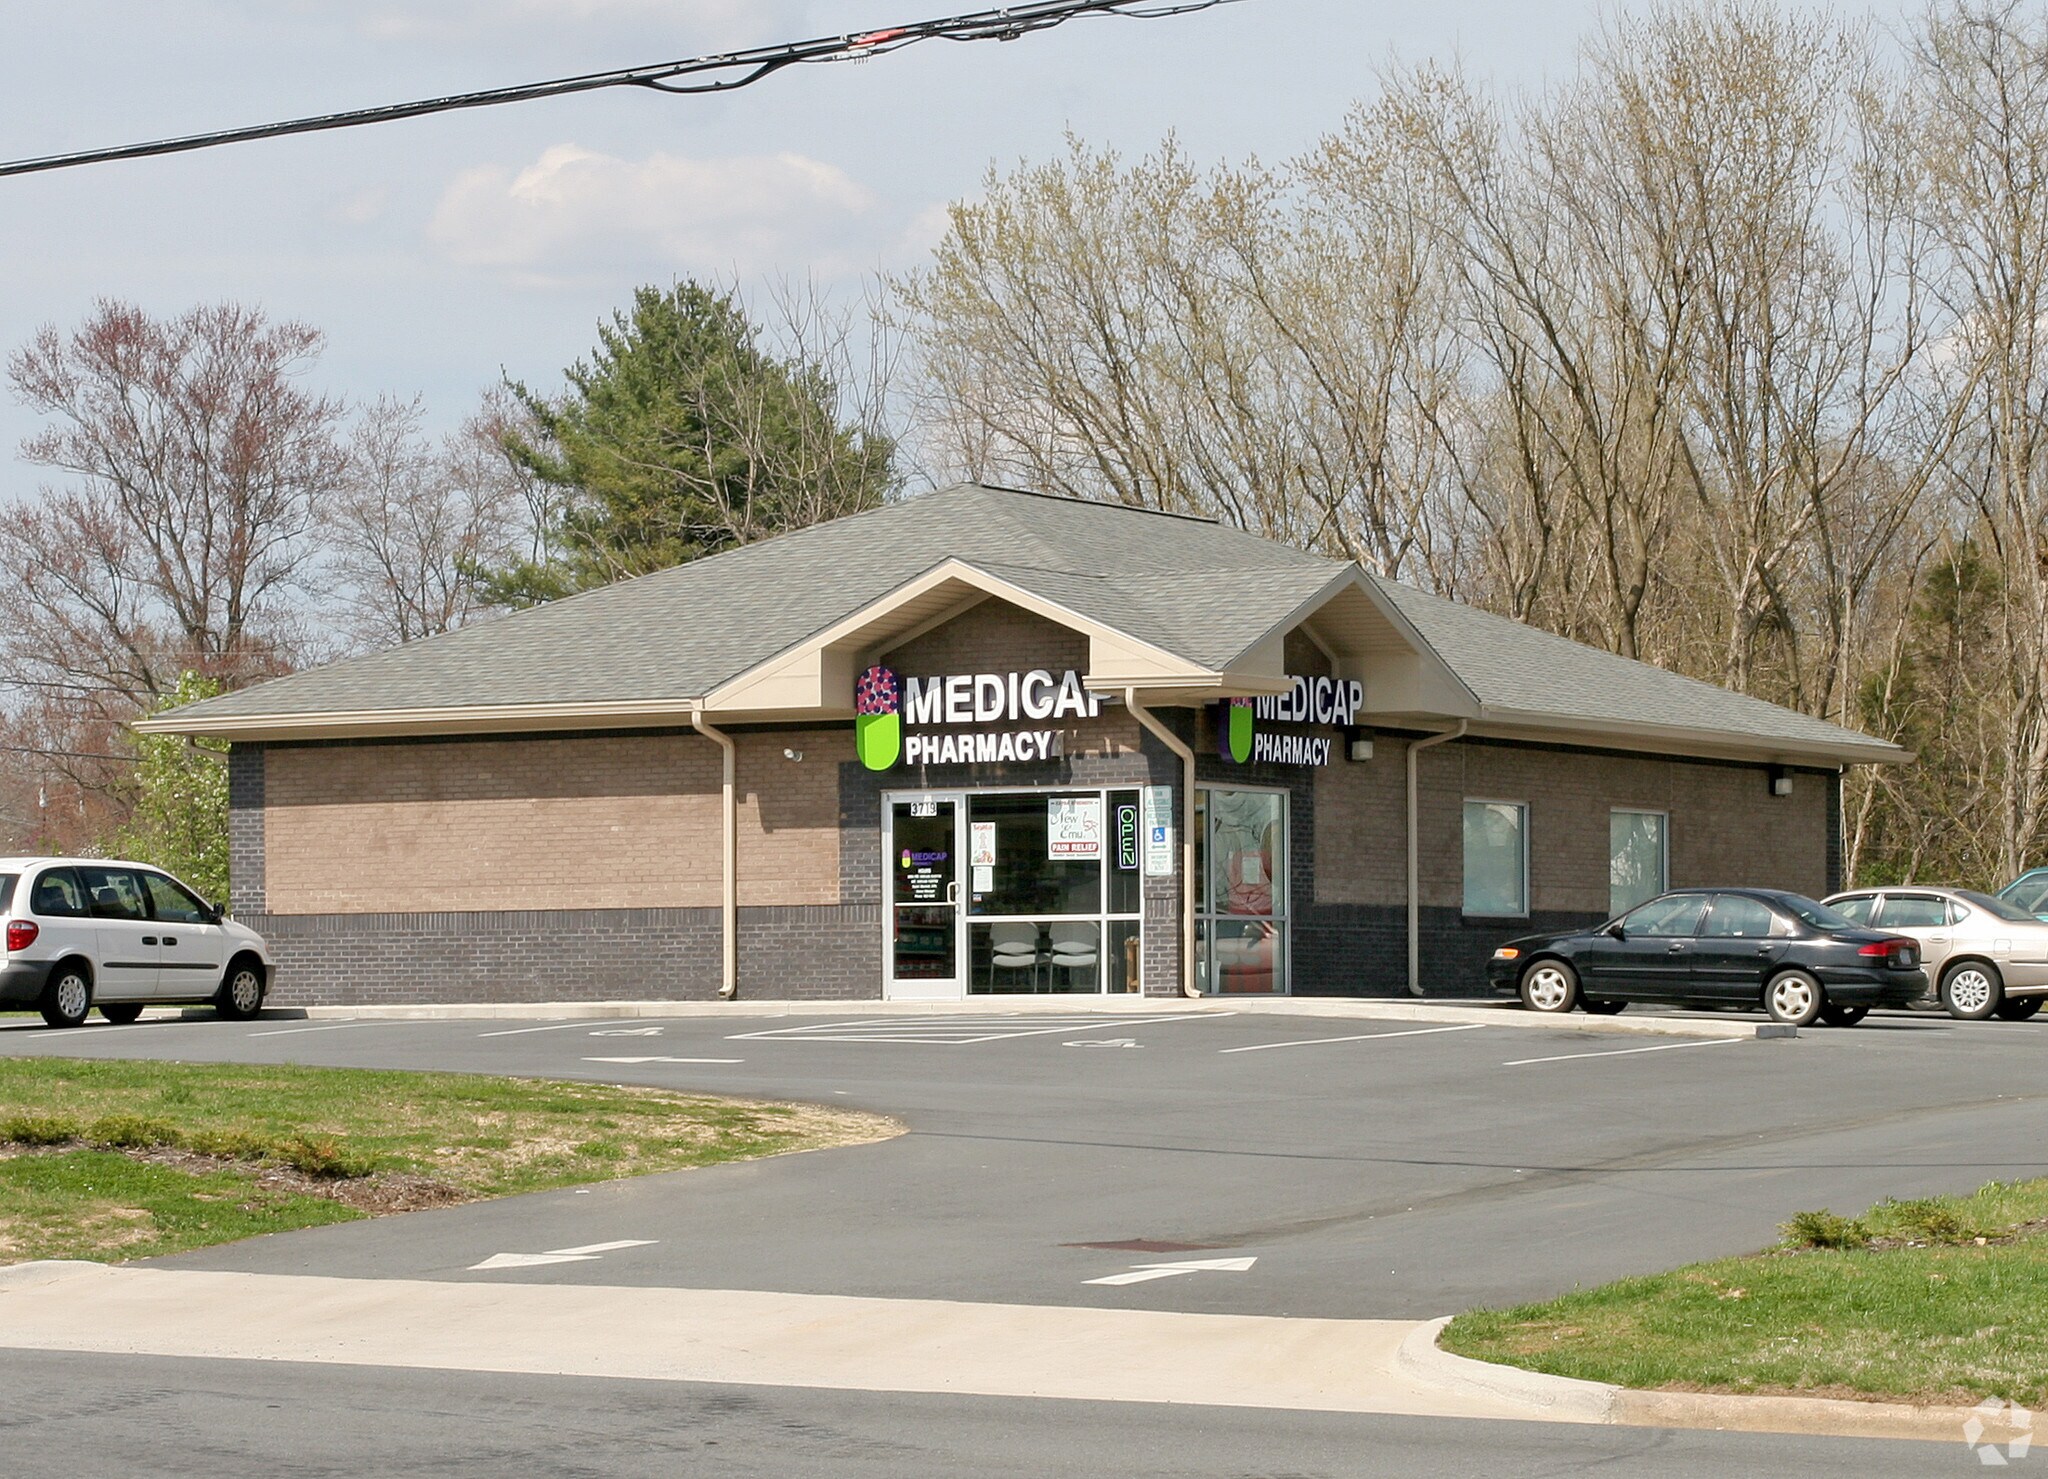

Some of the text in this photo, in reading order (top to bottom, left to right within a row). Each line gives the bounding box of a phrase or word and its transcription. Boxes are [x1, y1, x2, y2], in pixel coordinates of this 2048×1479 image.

[906, 731, 1051, 765] PHARMACY
[1254, 733, 1331, 766] PHARMACY
[911, 802, 936, 815] 3719
[1072, 842, 1098, 851] RELIEF
[1120, 808, 1135, 866] OPEN
